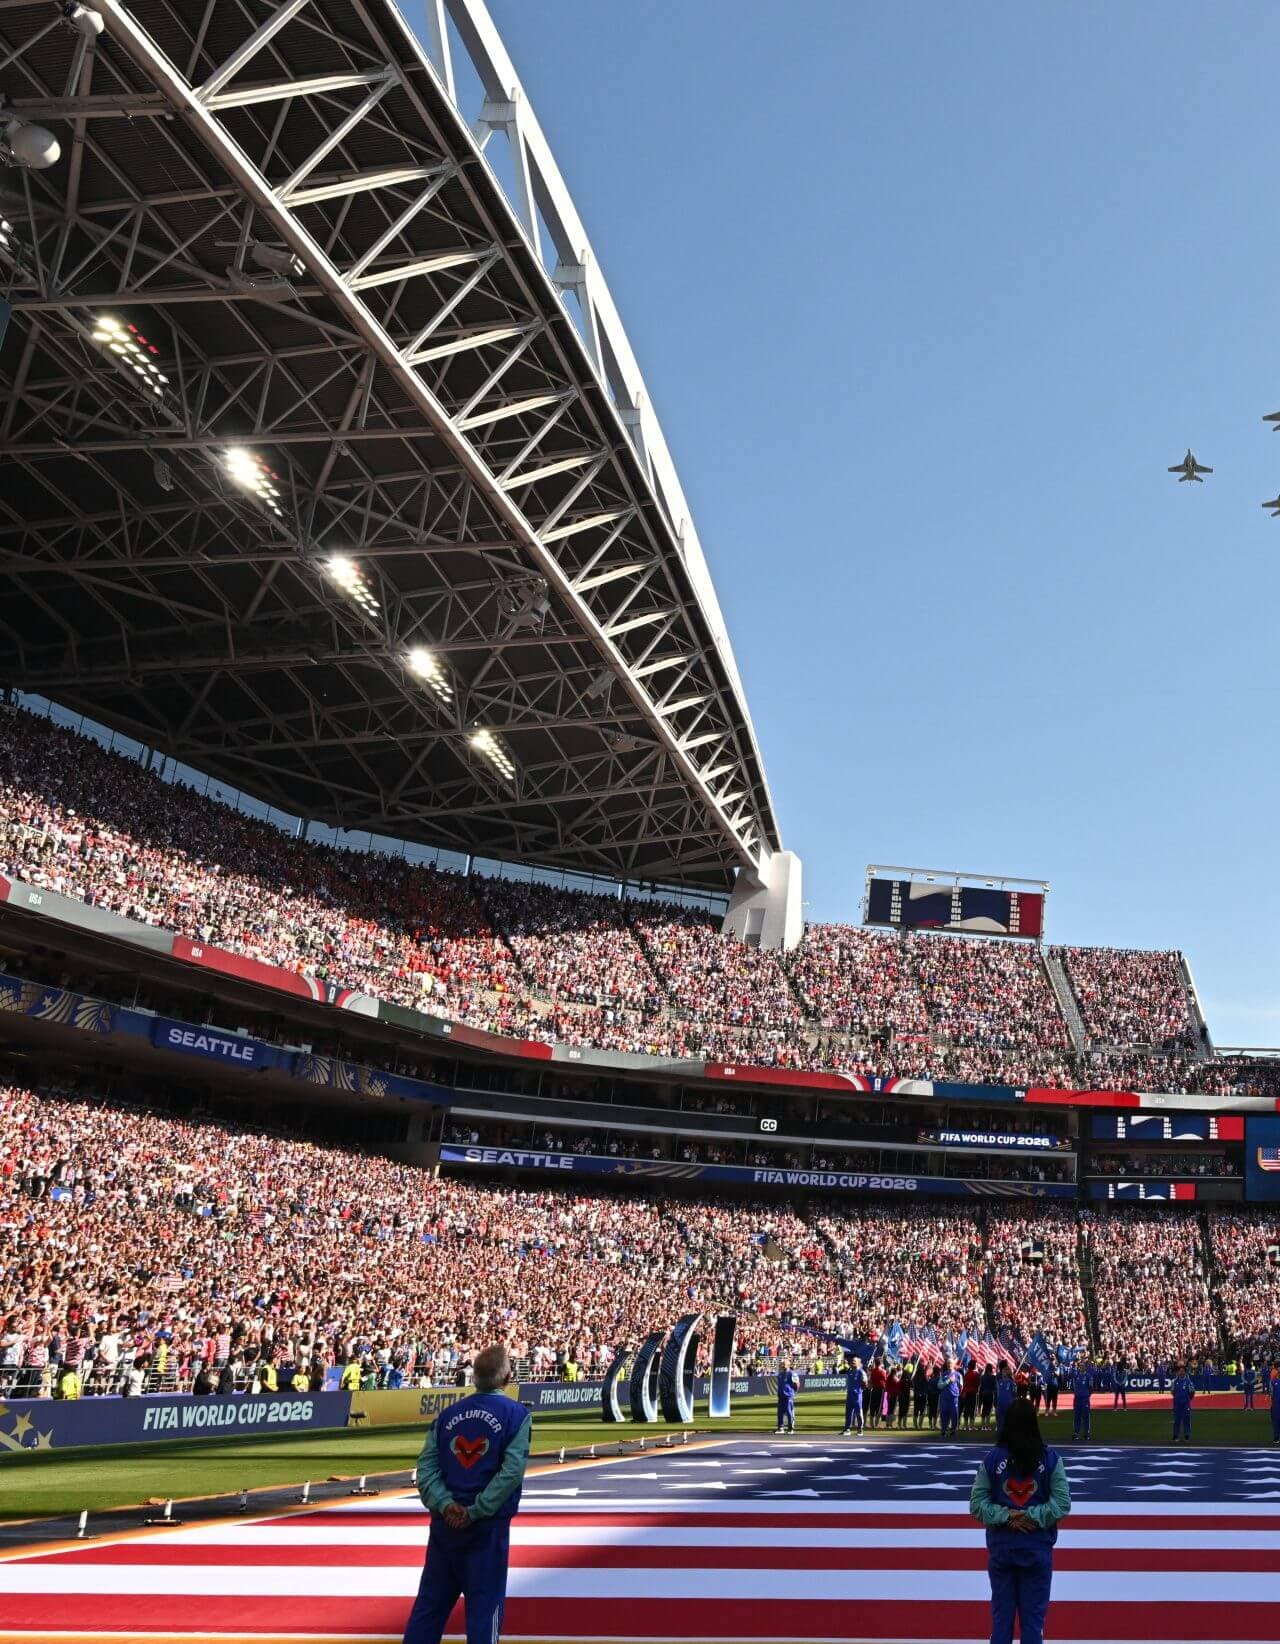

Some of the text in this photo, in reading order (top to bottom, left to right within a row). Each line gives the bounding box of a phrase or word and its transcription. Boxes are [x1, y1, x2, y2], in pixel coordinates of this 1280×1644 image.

[168, 1028, 254, 1061] SEATTLE
[762, 1120, 776, 1130] CC
[940, 1132, 1050, 1146] FIFA WORLD CUP 2026
[464, 1148, 574, 1169] SEATTLE
[753, 1170, 918, 1191] FIFA WORLD CUP 2026
[1130, 1378, 1152, 1388] CUP
[539, 1389, 556, 1405] FIFA
[556, 1388, 580, 1404] WORLD
[580, 1387, 592, 1402] CUP
[143, 1401, 314, 1431] FIFA WORLD CUP 2026
[445, 1409, 502, 1433] VOLUNTEER
